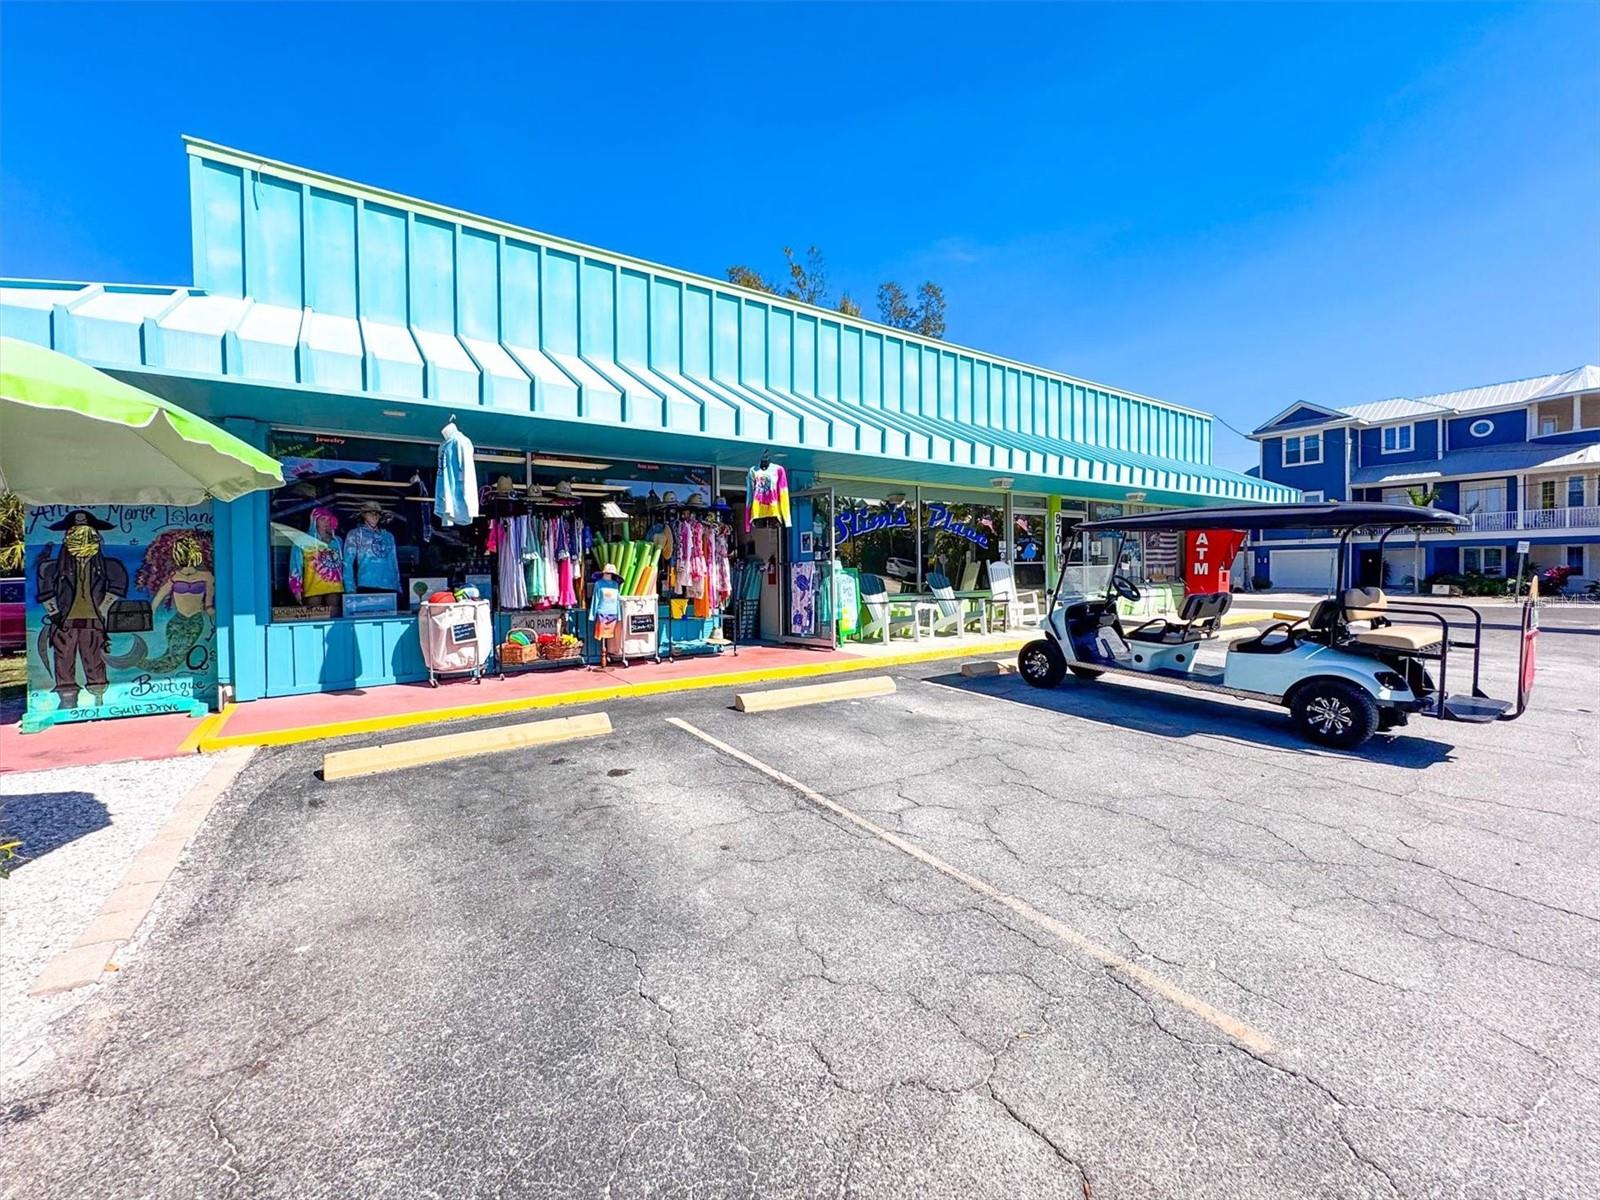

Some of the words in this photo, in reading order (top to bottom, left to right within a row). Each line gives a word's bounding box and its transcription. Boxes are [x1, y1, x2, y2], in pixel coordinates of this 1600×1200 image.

[315, 436, 345, 444] Jewelry
[835, 503, 911, 545] Slim's
[927, 503, 989, 550] Place
[1194, 532, 1209, 576] ATM
[130, 674, 206, 697] Boutique
[109, 704, 143, 716] Gulf
[145, 702, 180, 713] Drive
